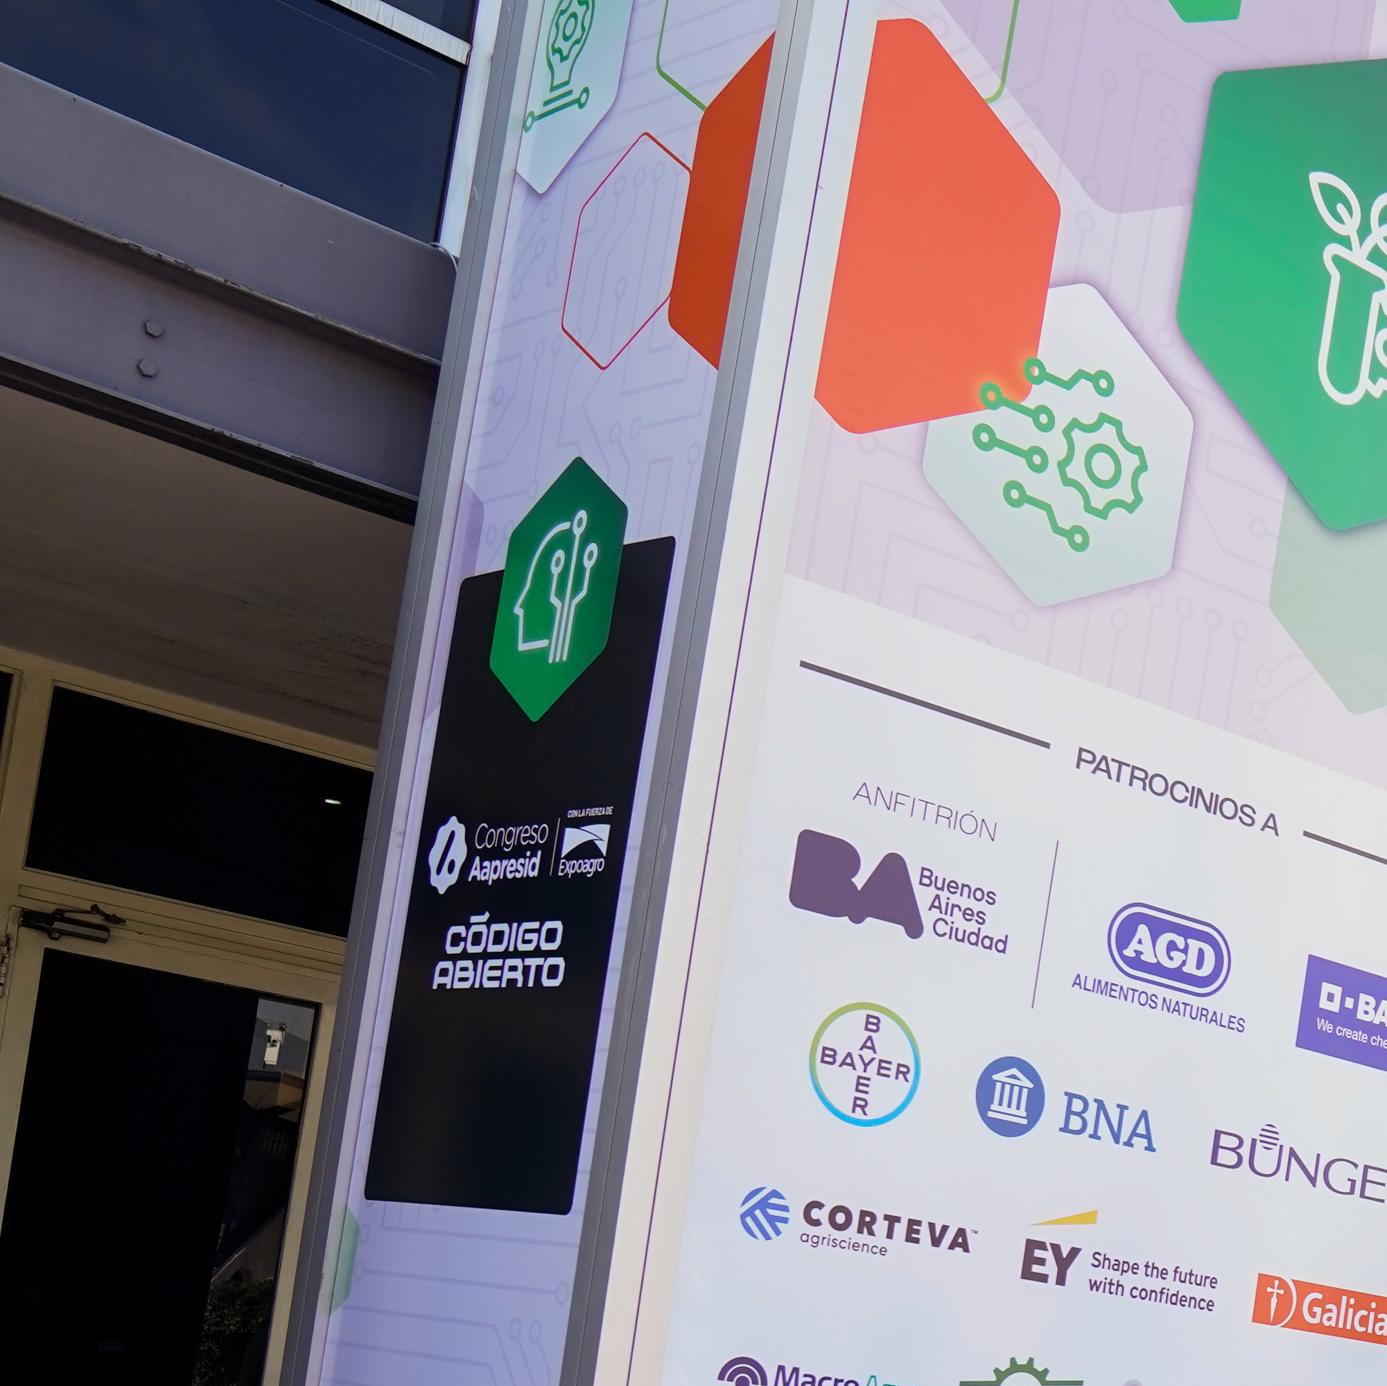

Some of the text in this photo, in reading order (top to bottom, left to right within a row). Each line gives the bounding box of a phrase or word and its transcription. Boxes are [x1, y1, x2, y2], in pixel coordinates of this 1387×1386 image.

[853, 780, 998, 842] ANFITRIÓN
[1075, 747, 1280, 838] PATROCINIOS A
[474, 823, 549, 851] Congreso
[468, 850, 542, 885] Aapresid
[558, 858, 605, 878] Expoagro
[918, 866, 998, 907] Buenos
[928, 894, 987, 927] Aires
[445, 911, 563, 954] CÓDIGO
[932, 918, 1010, 955] Ciudad
[1122, 925, 1217, 980] AGD
[432, 957, 566, 989] ABIERTO
[1072, 973, 1247, 1033] ALIMENTOS NATURALES
[1316, 1017, 1340, 1036] We
[1342, 1024, 1377, 1045] create
[820, 1046, 912, 1083] BAYER
[1058, 1091, 1157, 1154] BNA
[800, 1229, 888, 1257] agriscience
[803, 1200, 971, 1253] CORTEVA
[1020, 1238, 1082, 1287] EY
[1091, 1250, 1219, 1290] Shape the future
[1088, 1276, 1216, 1313] with confidence
